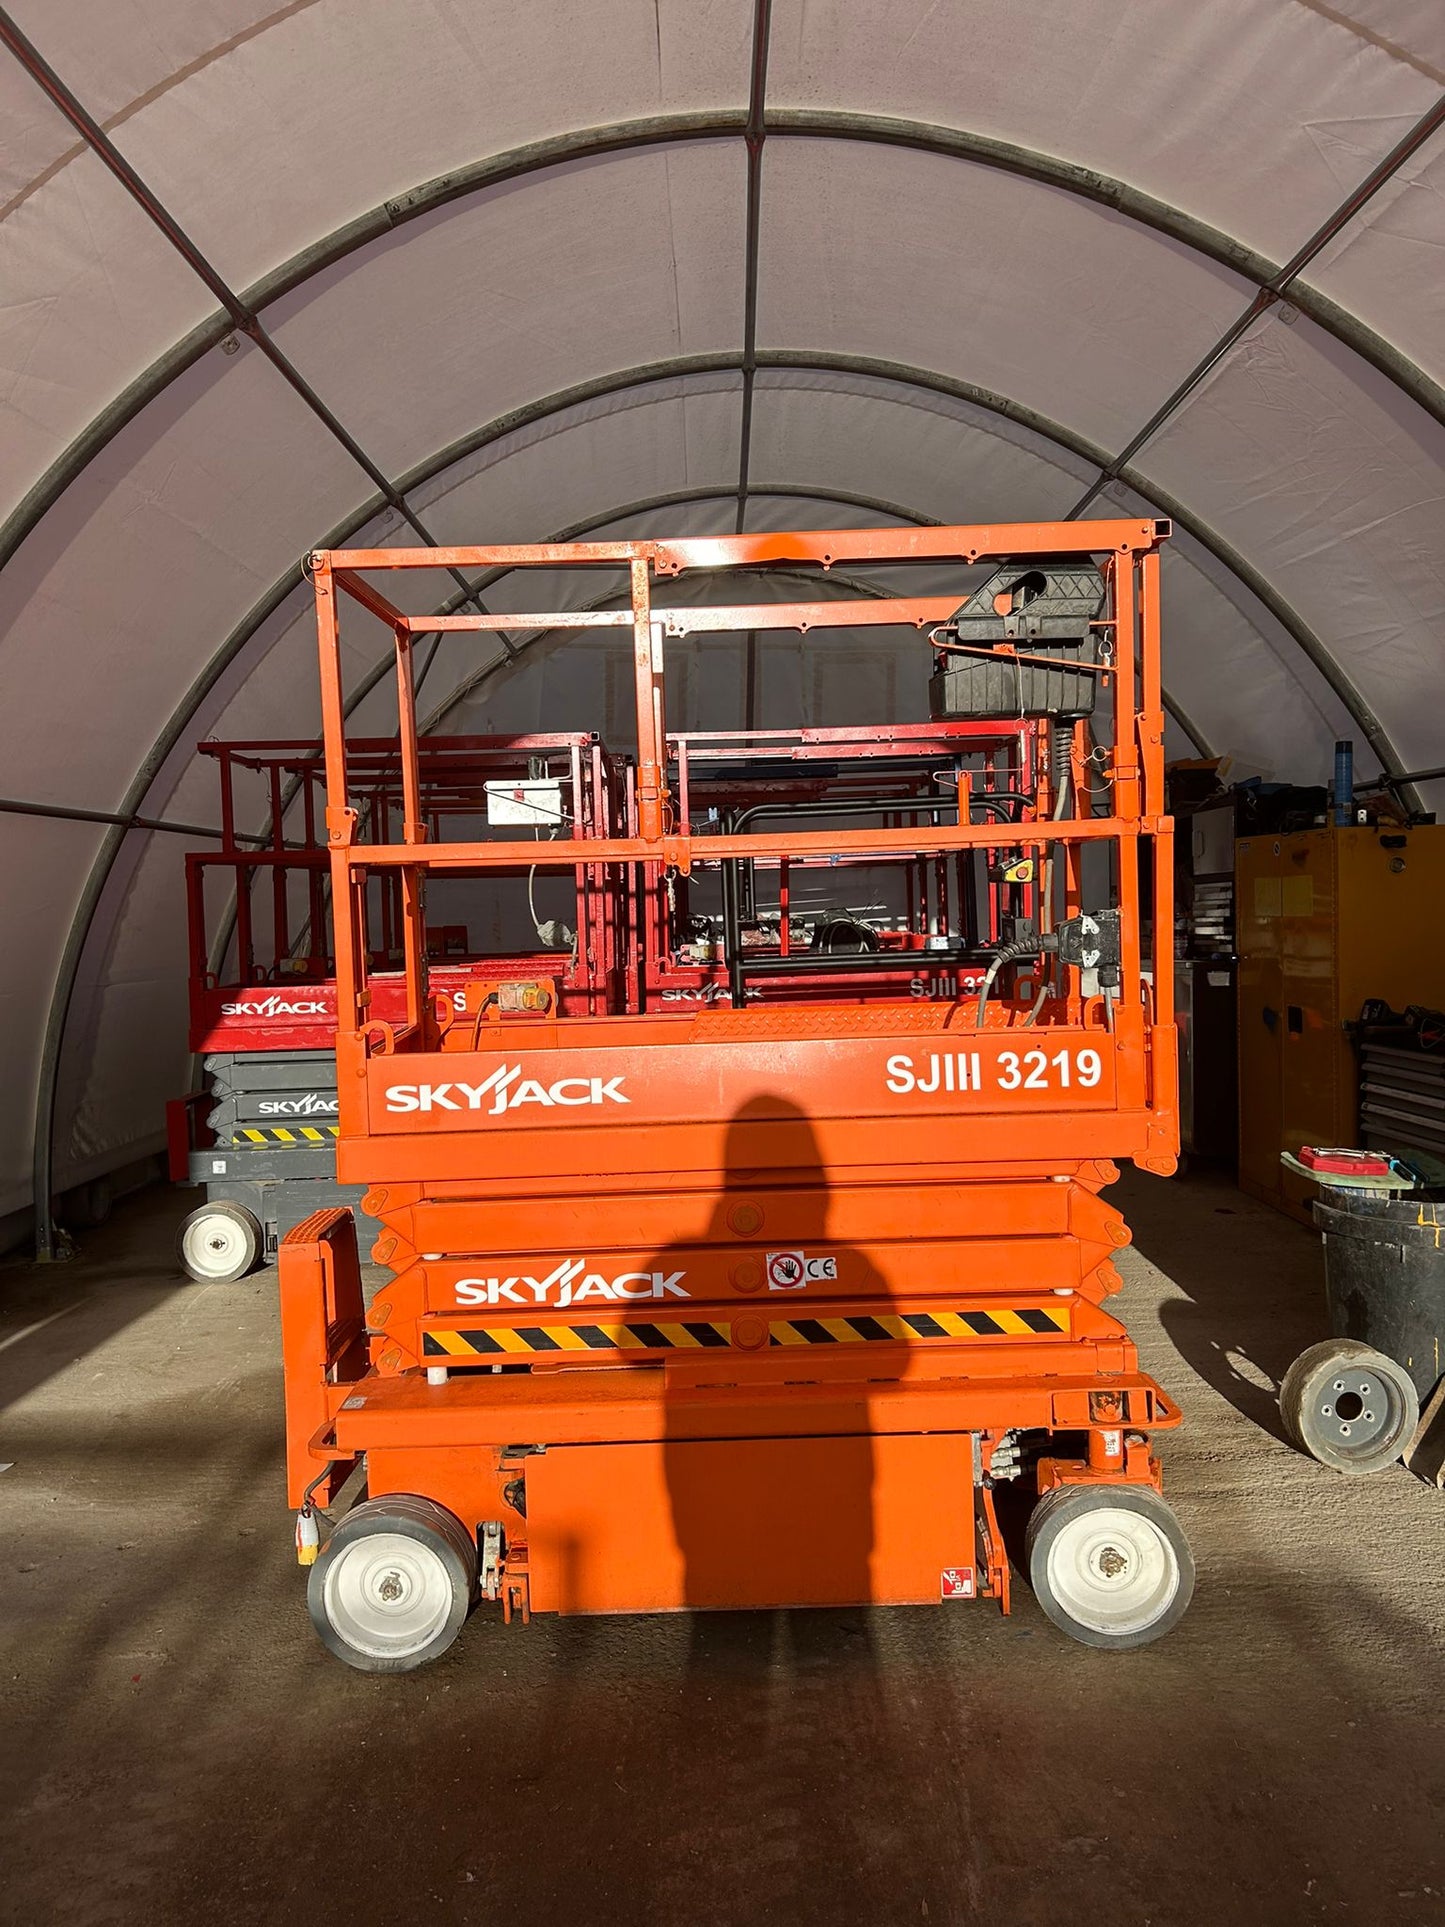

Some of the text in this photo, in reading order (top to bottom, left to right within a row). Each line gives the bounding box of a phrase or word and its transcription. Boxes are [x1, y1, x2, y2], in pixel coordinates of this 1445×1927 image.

[910, 977, 956, 998] SJIII
[221, 995, 329, 1017] SKYJACK
[885, 1048, 1102, 1093] SJIII 3219
[258, 1093, 339, 1115] SKYJAC
[385, 1063, 632, 1115] SKYJACK
[454, 1258, 692, 1308] SKYJACK
